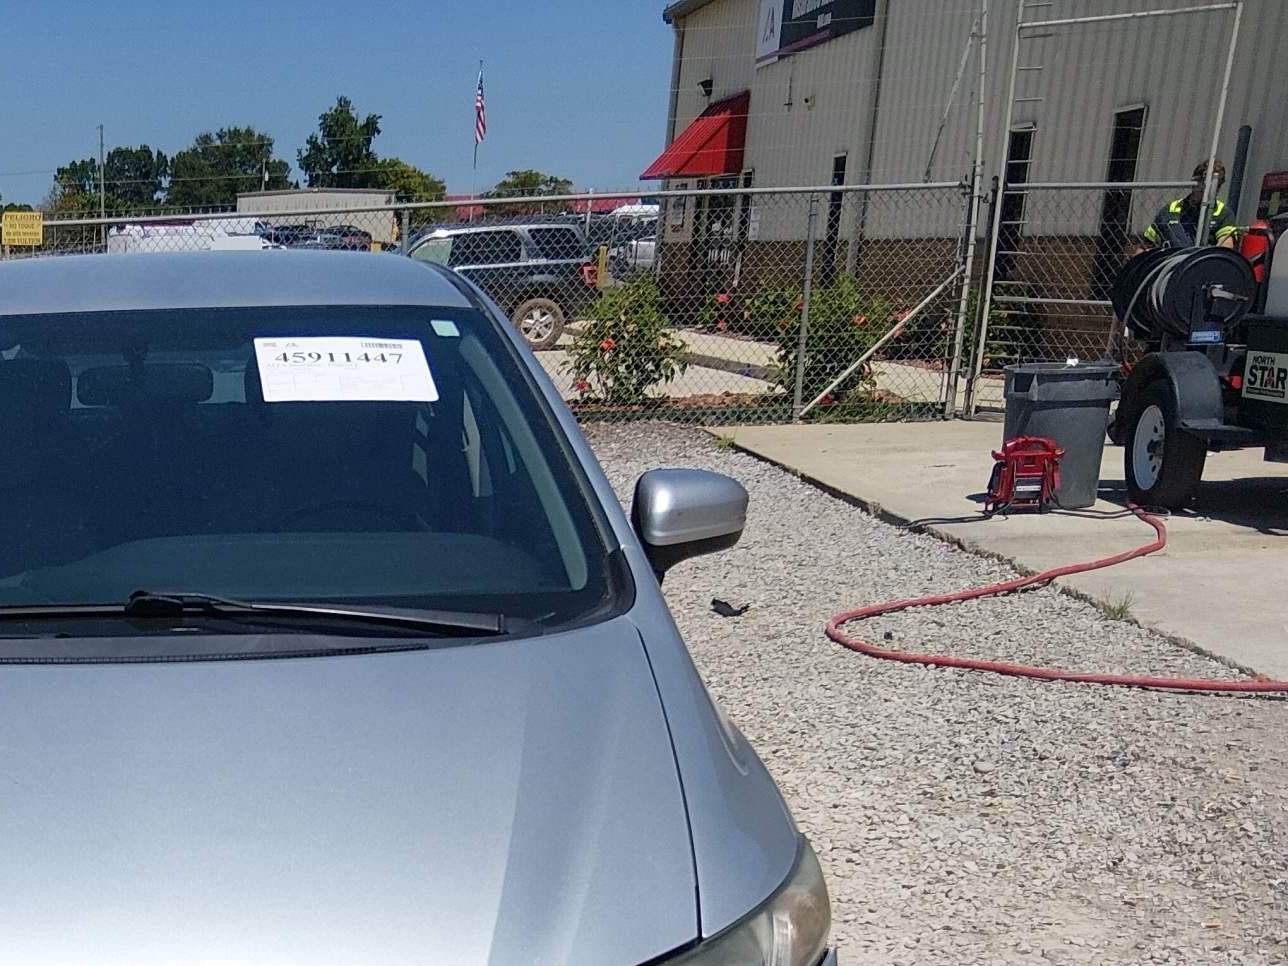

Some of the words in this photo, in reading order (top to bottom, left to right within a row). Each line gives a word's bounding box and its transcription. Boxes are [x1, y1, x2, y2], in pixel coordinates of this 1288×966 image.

[274, 351, 403, 364] 45911447
[1252, 355, 1276, 366] NORTH
[1247, 364, 1288, 390] STAR
